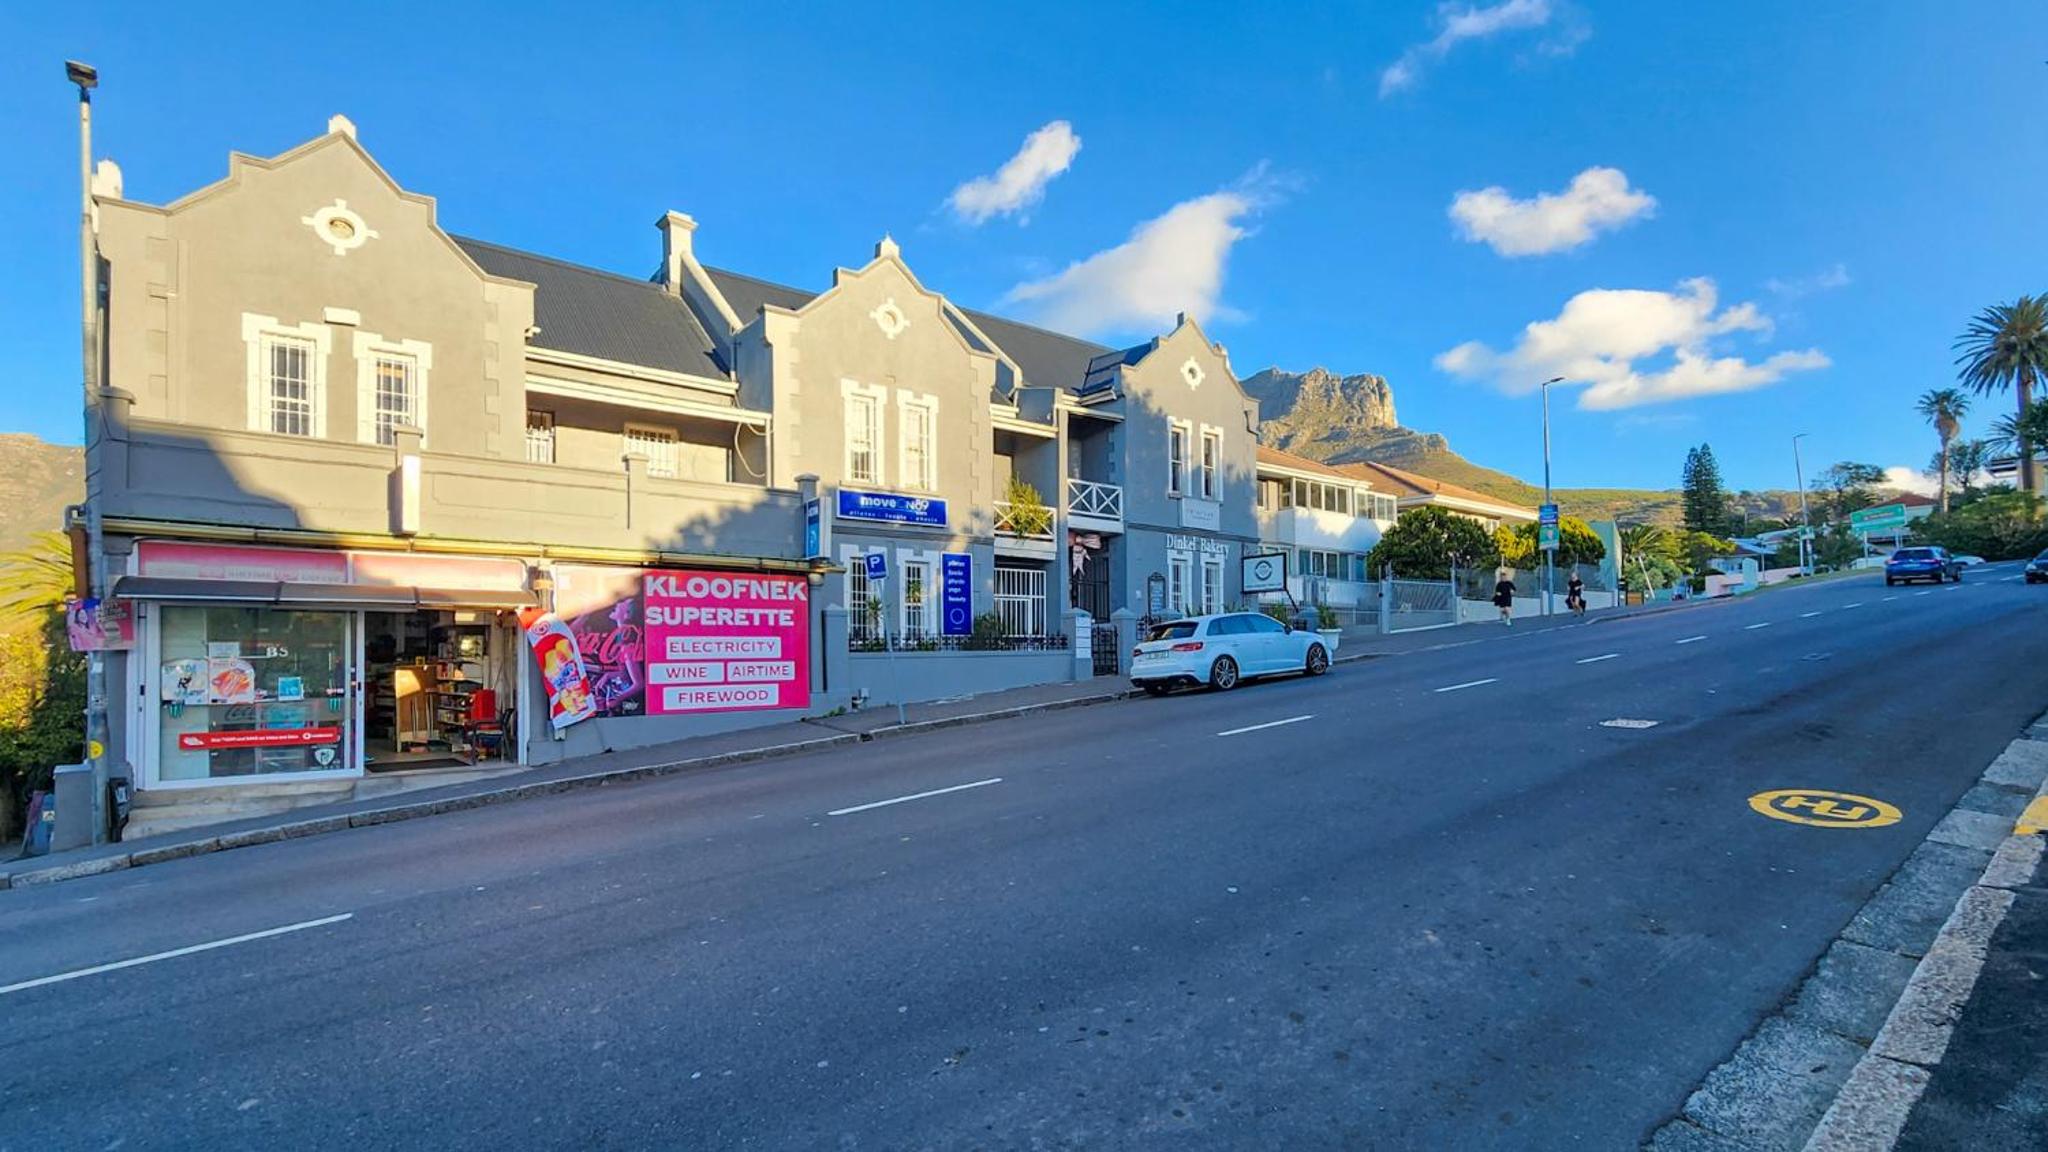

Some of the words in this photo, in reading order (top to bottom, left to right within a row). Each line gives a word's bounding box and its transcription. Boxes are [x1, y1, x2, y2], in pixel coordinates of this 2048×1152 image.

[1167, 534, 1196, 551] Dinkel
[1201, 538, 1229, 558] Bakery
[869, 557, 881, 569] P
[646, 576, 807, 601] KLOOFNEK
[645, 606, 795, 627] SUPERETTE
[670, 641, 775, 654] ELECTRICITY
[666, 667, 708, 679] WINE
[732, 665, 790, 677] AIRTIME
[678, 690, 769, 703] FIREWOOD
